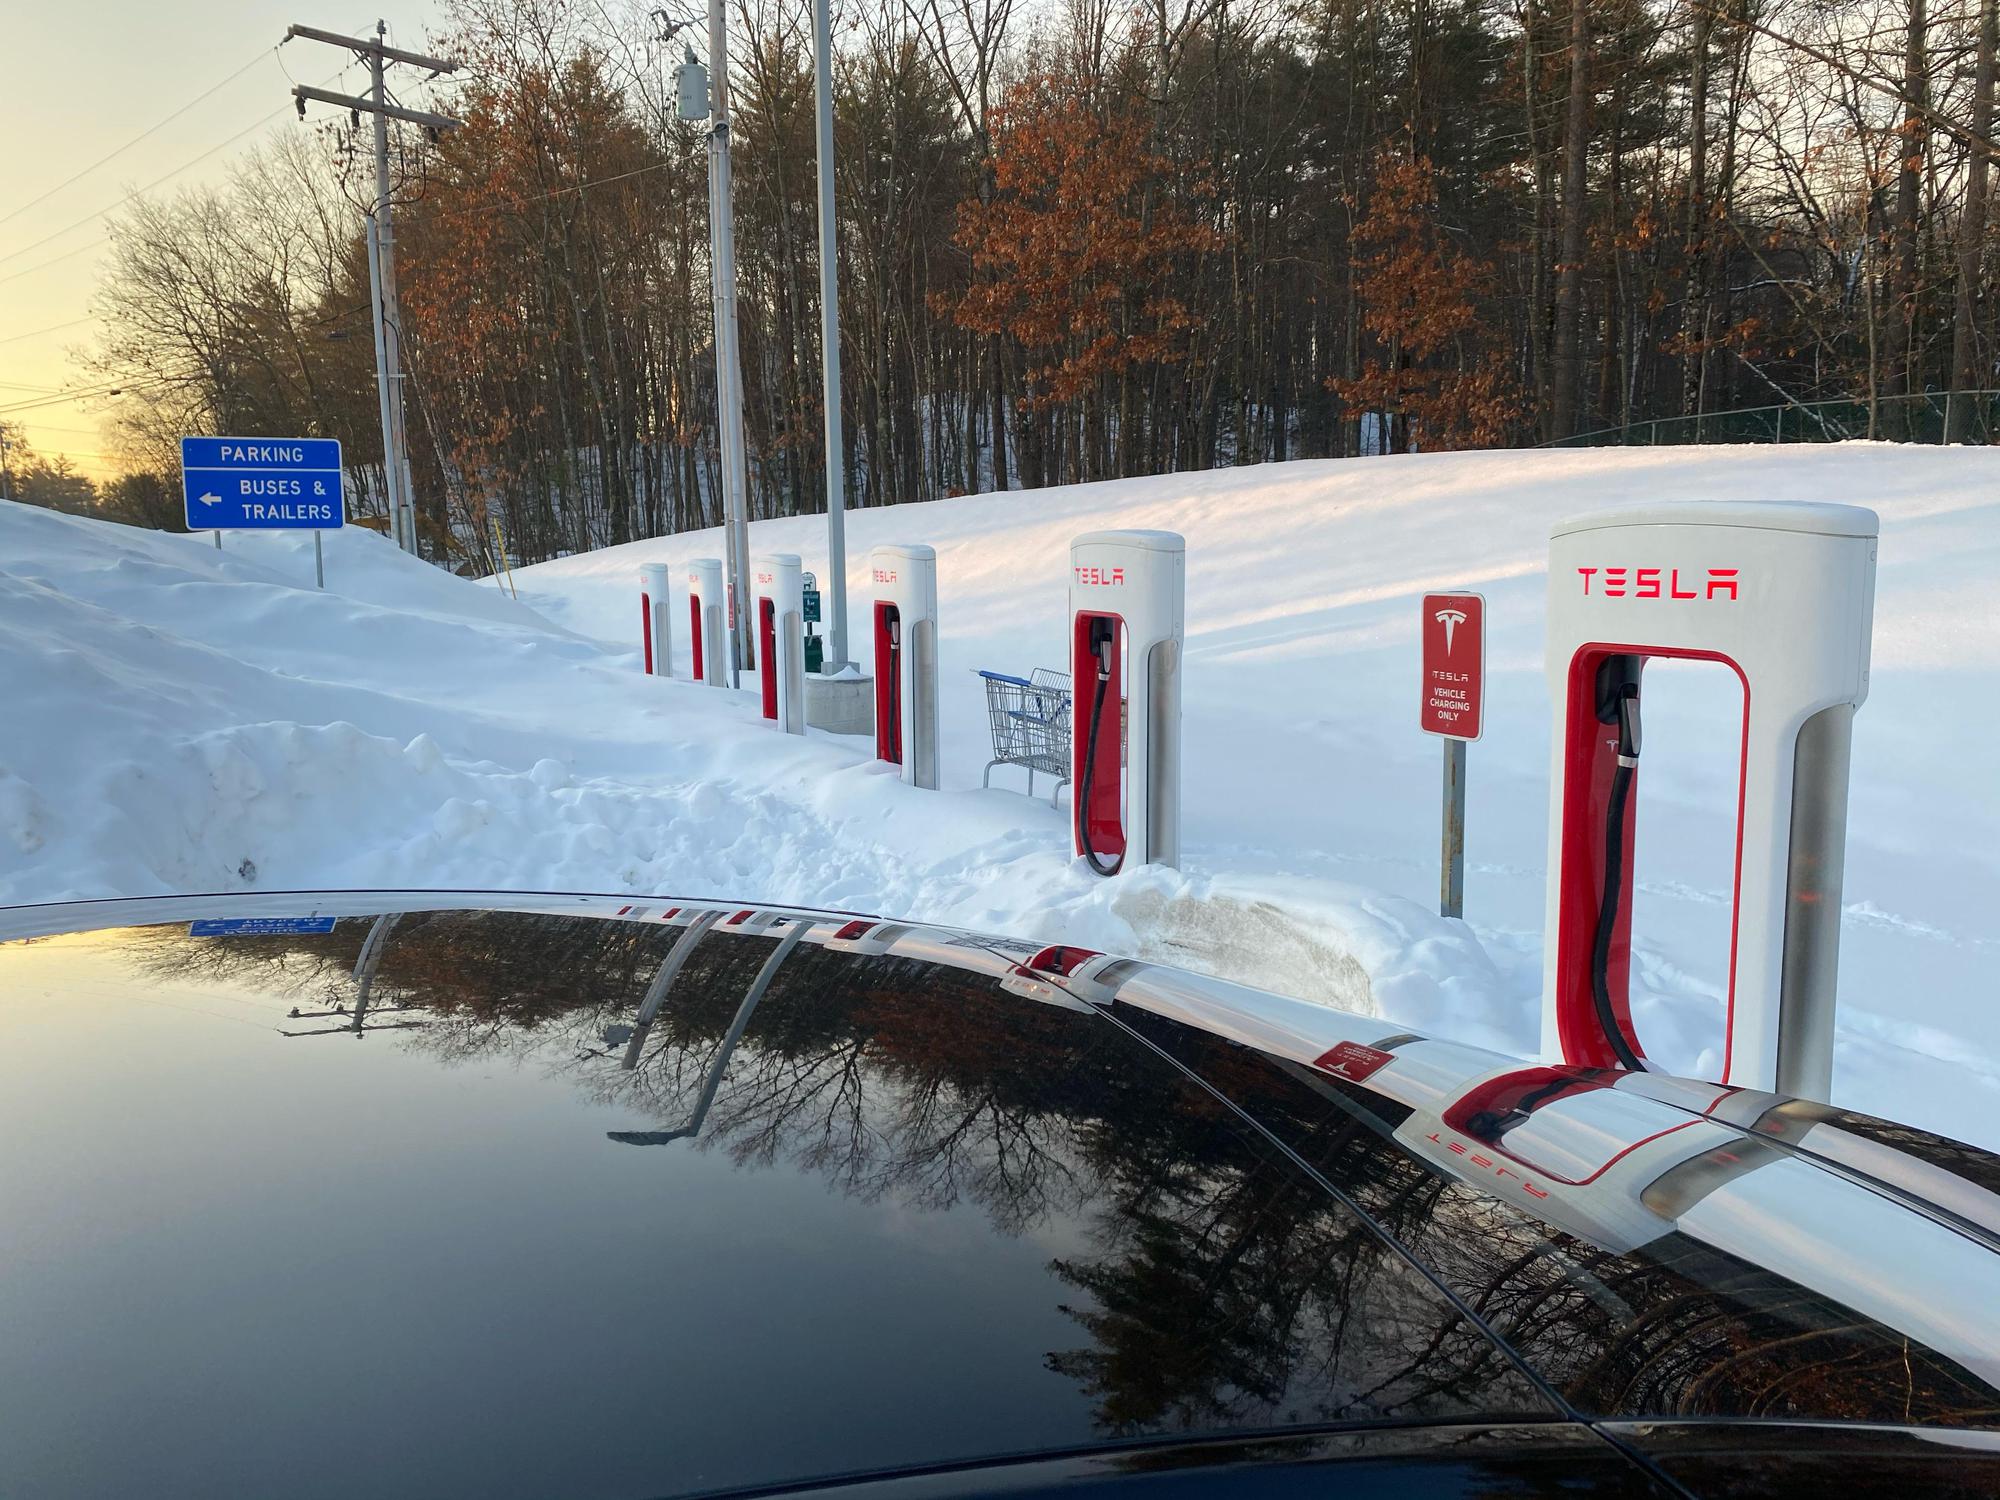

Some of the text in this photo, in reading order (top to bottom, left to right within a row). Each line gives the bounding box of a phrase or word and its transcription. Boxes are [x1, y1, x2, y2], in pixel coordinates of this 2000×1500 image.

[220, 446, 304, 462] PARKING
[240, 480, 326, 495] BUSES &
[242, 504, 332, 520] TRAILERS
[1075, 567, 1124, 585] TESLA
[1577, 568, 1739, 600] TESLA
[1432, 670, 1469, 682] TESLA
[1434, 687, 1466, 699] VEHICLE
[1430, 697, 1470, 711] CHARGING
[1438, 710, 1459, 721] ONLY
